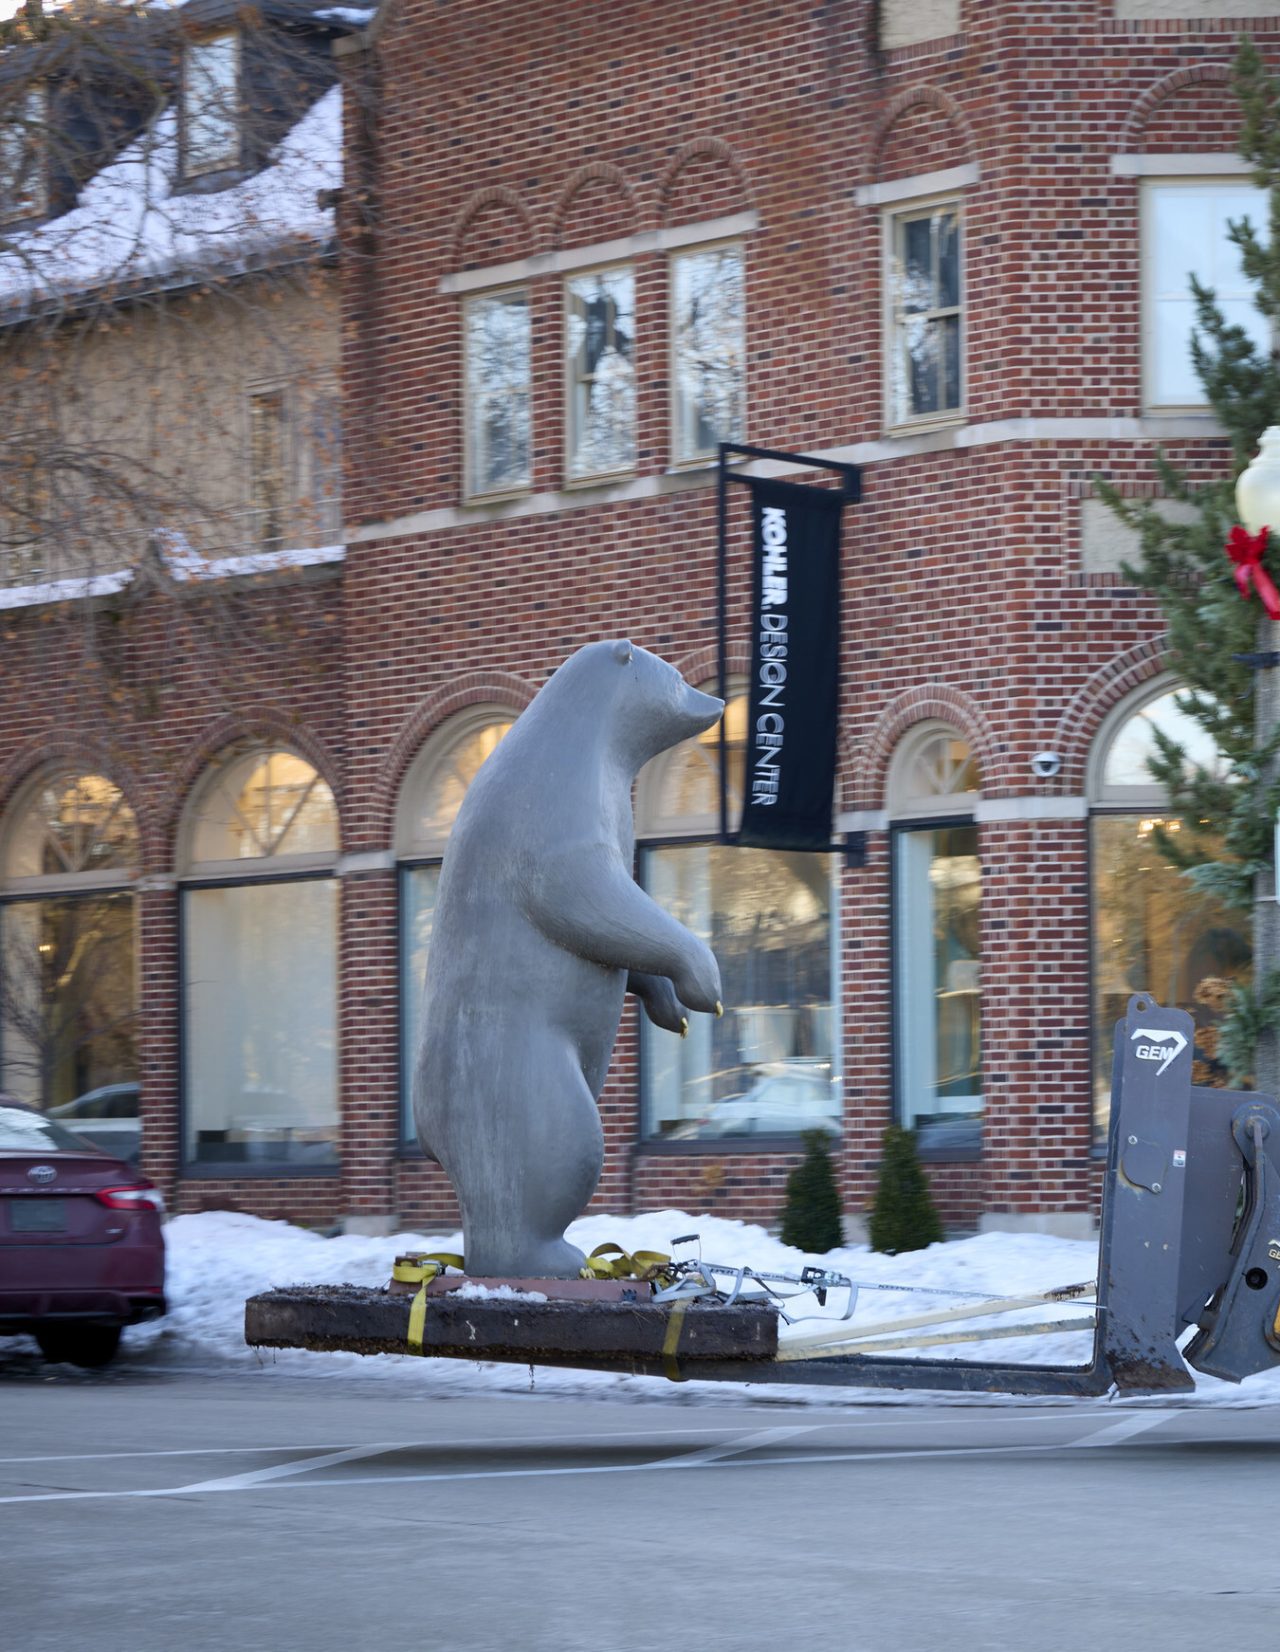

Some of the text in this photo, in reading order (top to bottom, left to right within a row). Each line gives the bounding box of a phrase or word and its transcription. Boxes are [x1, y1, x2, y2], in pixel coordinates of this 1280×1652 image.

[758, 614, 789, 707] DESIGN
[751, 712, 785, 806] CENTER
[1136, 1045, 1174, 1061] GEM
